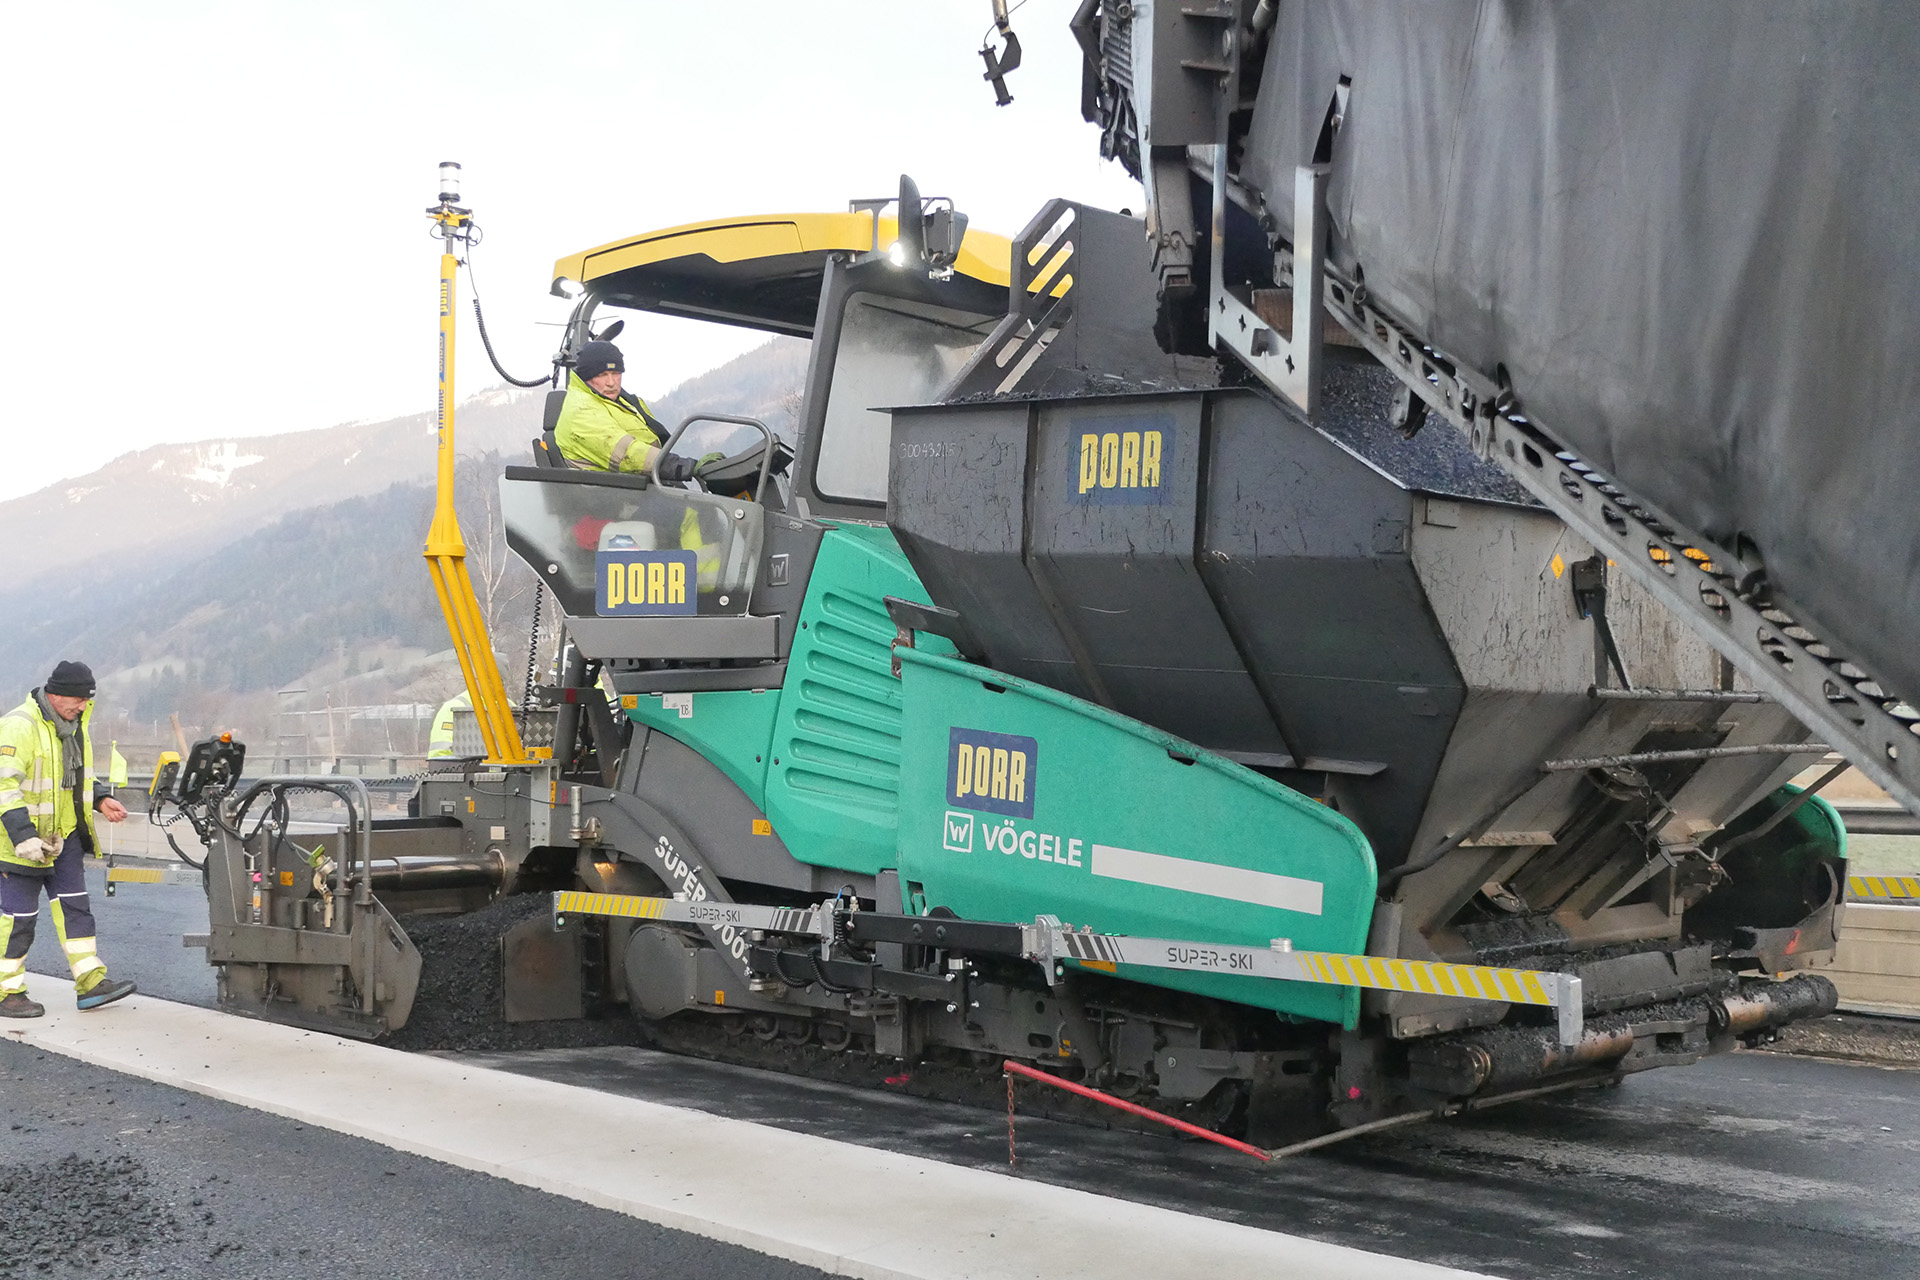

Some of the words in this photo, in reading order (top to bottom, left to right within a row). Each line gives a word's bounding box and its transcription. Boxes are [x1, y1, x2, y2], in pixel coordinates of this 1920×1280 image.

[981, 818, 1083, 868] VÖGELE
[689, 906, 742, 923] SUPER-SKI
[1167, 947, 1253, 970] SUPER-SKI
